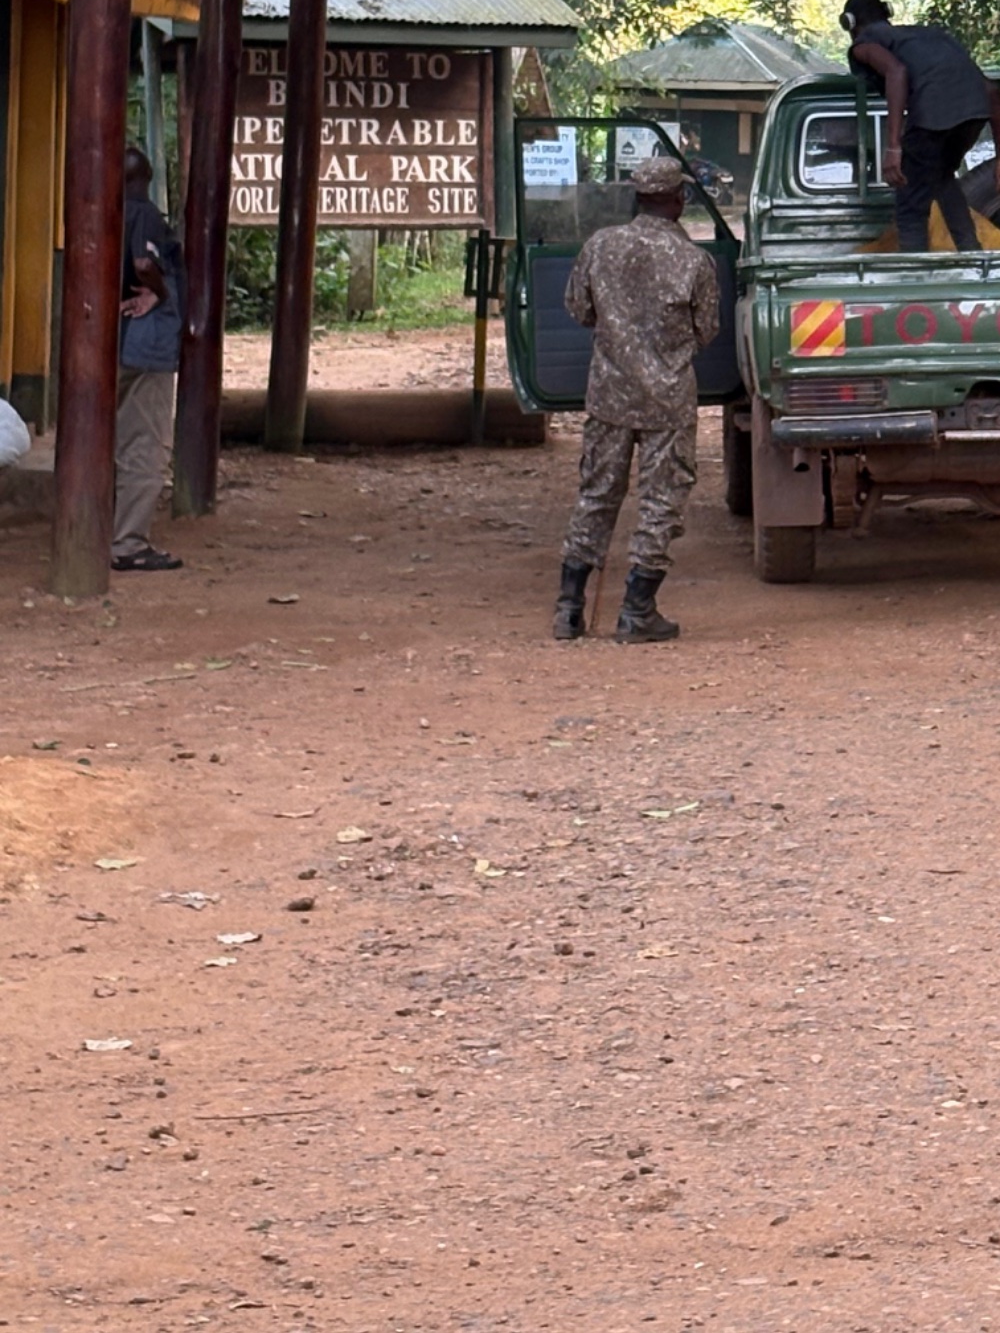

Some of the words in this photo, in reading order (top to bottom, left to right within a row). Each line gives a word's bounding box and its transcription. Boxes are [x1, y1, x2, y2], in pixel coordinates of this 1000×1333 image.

[243, 48, 389, 79] ELOME
[406, 52, 451, 80] TO
[267, 79, 410, 109] BINDI
[233, 116, 477, 146] PEETRABLE
[390, 154, 475, 183] PARK
[229, 186, 280, 214] ORL
[317, 186, 409, 214] ERITAGE
[428, 187, 477, 214] SITE
